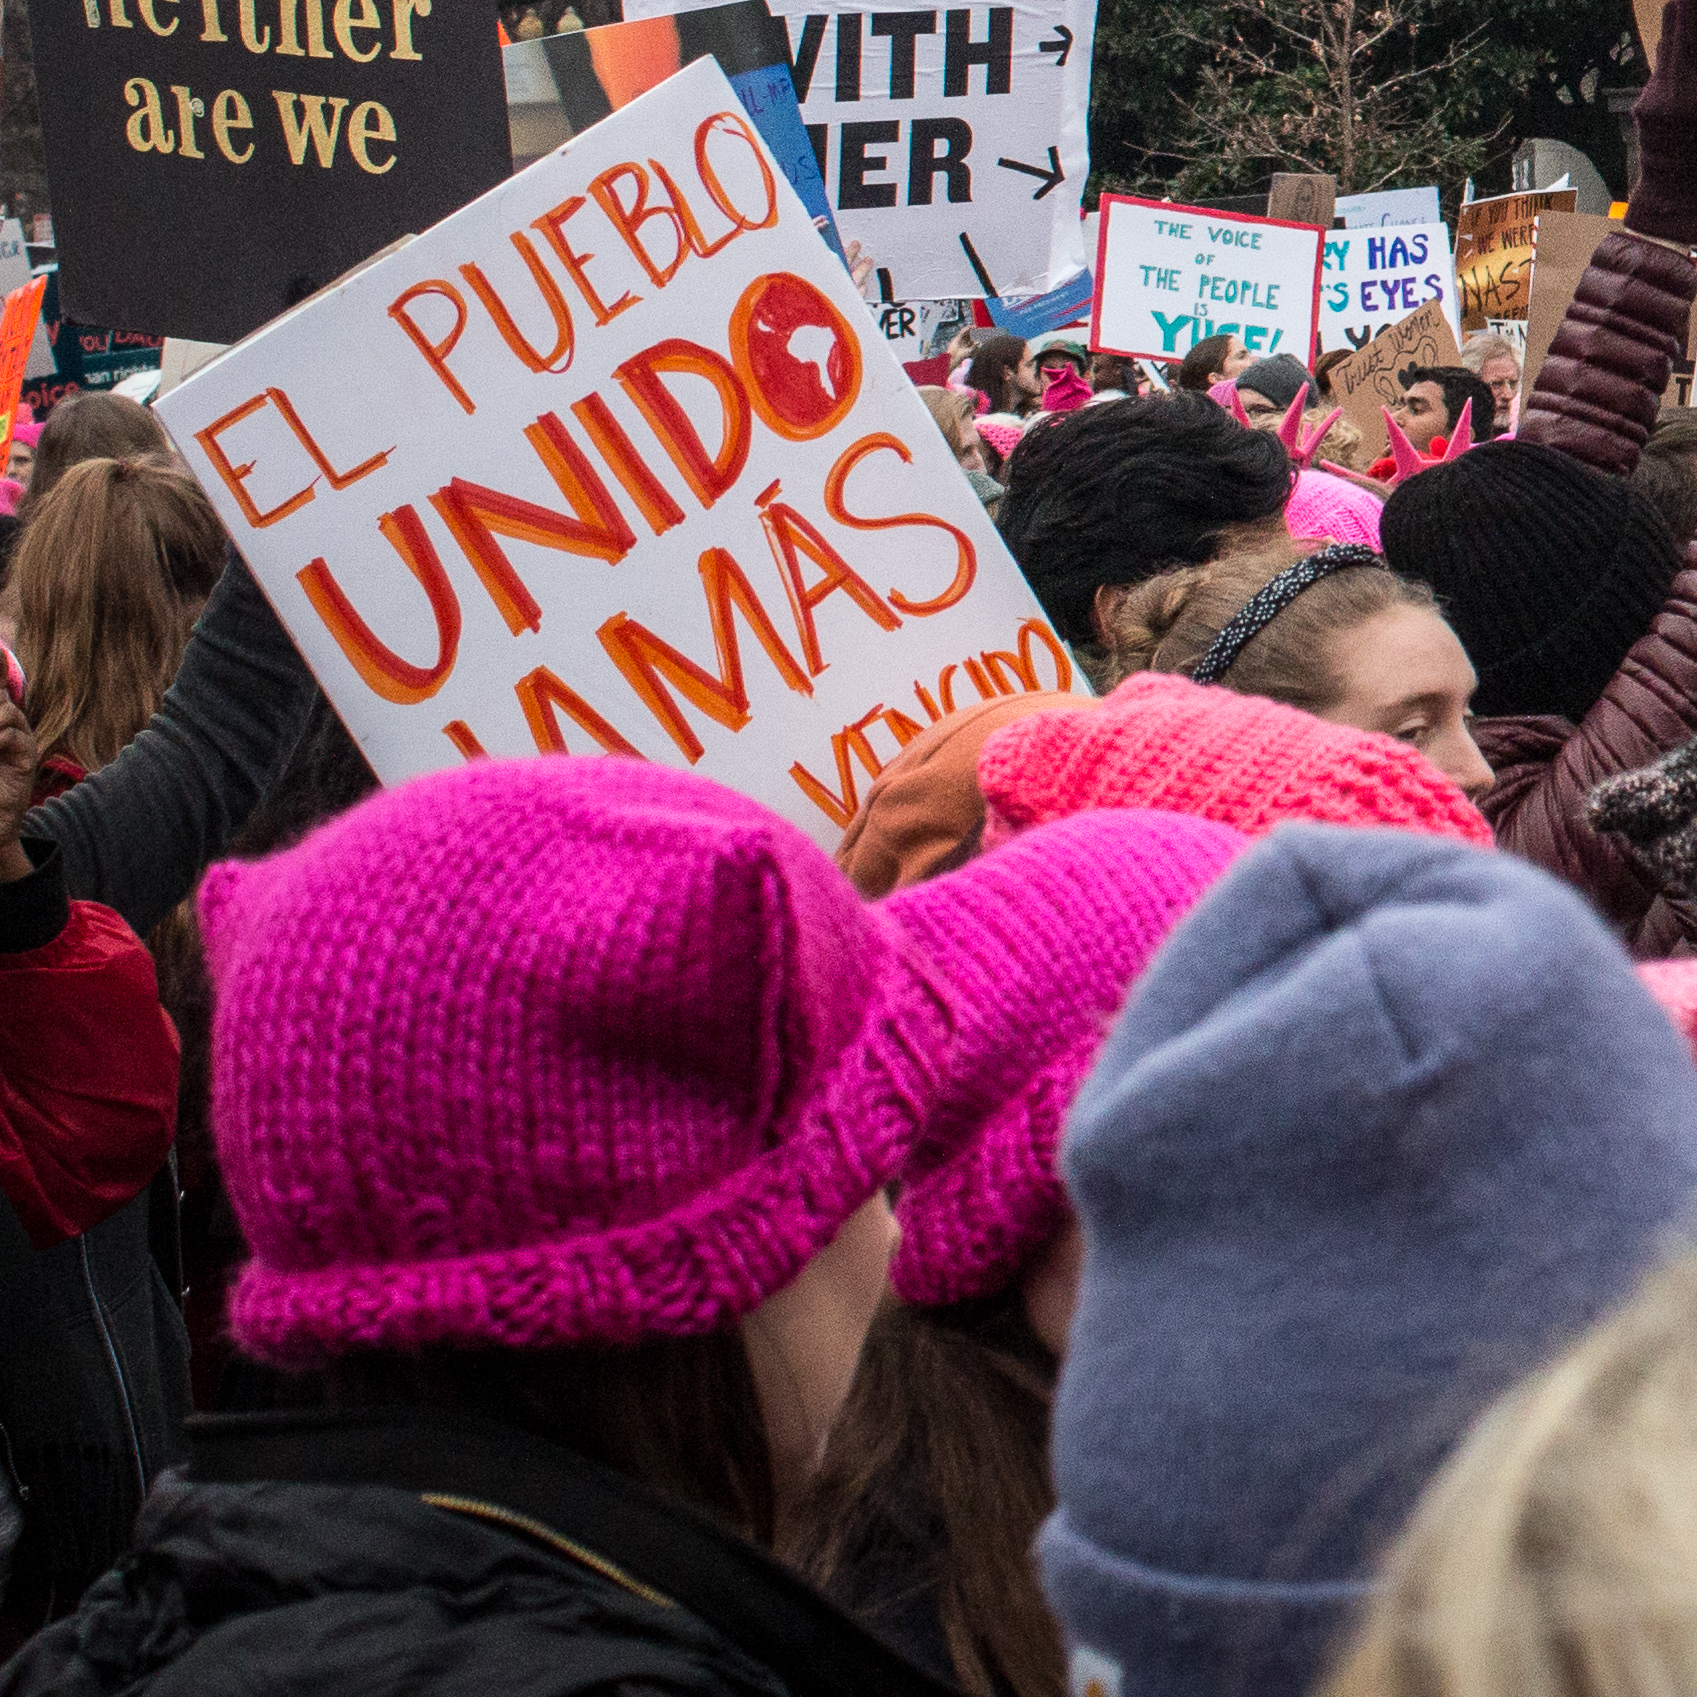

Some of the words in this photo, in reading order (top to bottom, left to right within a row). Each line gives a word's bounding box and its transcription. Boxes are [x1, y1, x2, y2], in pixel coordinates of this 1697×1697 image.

[125, 76, 255, 166] are
[271, 90, 399, 175] we
[807, 117, 973, 210] ER
[1154, 219, 1193, 239] THE
[1207, 226, 1263, 250] VOICE
[1367, 233, 1430, 271] HAS
[1502, 223, 1535, 250] WERE
[1194, 252, 1216, 265] OF
[1139, 264, 1182, 292] THE
[1198, 274, 1280, 310] PEOPLE
[1360, 273, 1444, 312] EYES
[194, 387, 395, 529] EL
[387, 110, 780, 414] PUEBLO
[1193, 302, 1209, 317] IS
[295, 271, 864, 705] UNIDO
